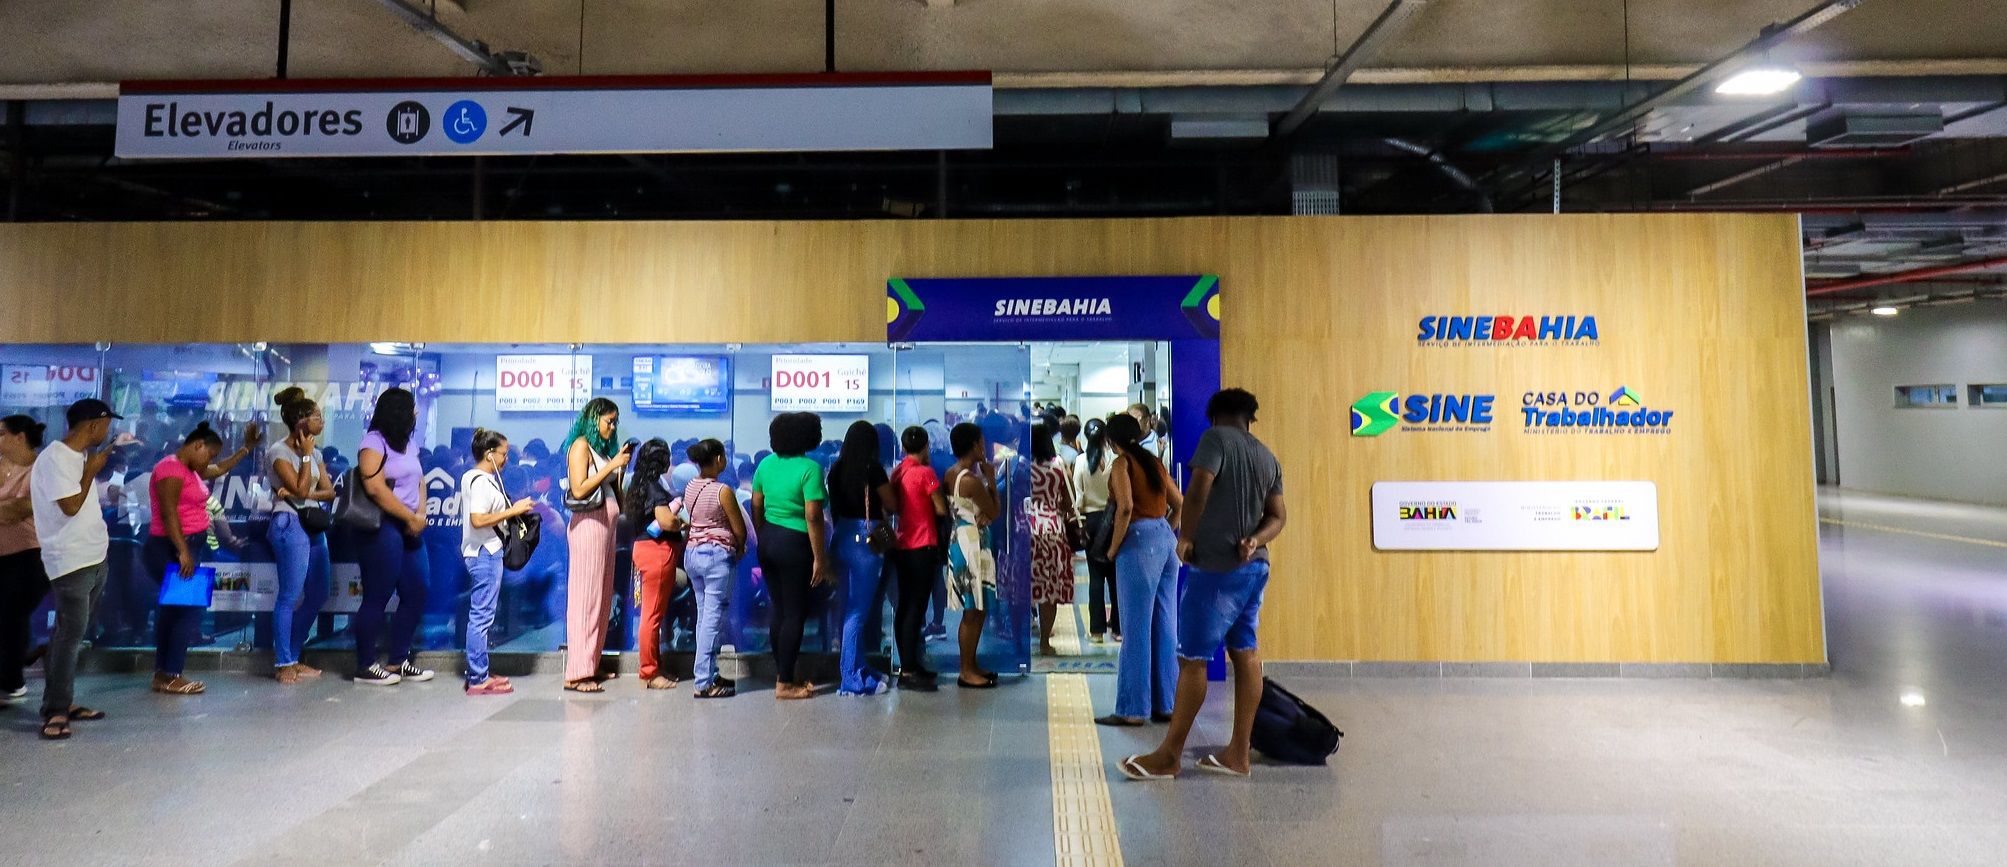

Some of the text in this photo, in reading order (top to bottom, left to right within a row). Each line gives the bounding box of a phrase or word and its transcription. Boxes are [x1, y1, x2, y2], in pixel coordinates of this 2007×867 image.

[144, 100, 363, 137] Elevadores
[227, 140, 282, 151] Elevators
[994, 298, 1112, 316] SINEBAHIA
[1417, 315, 1599, 341] SINEBAHIA
[500, 370, 555, 388] D001
[570, 378, 584, 390] 15
[776, 370, 830, 388] D001
[845, 379, 860, 391] 15
[1522, 391, 1599, 407] CASA DO
[1402, 394, 1495, 424] SINE
[1521, 407, 1673, 428] Trabalhador
[1400, 507, 1457, 520] BAHIA
